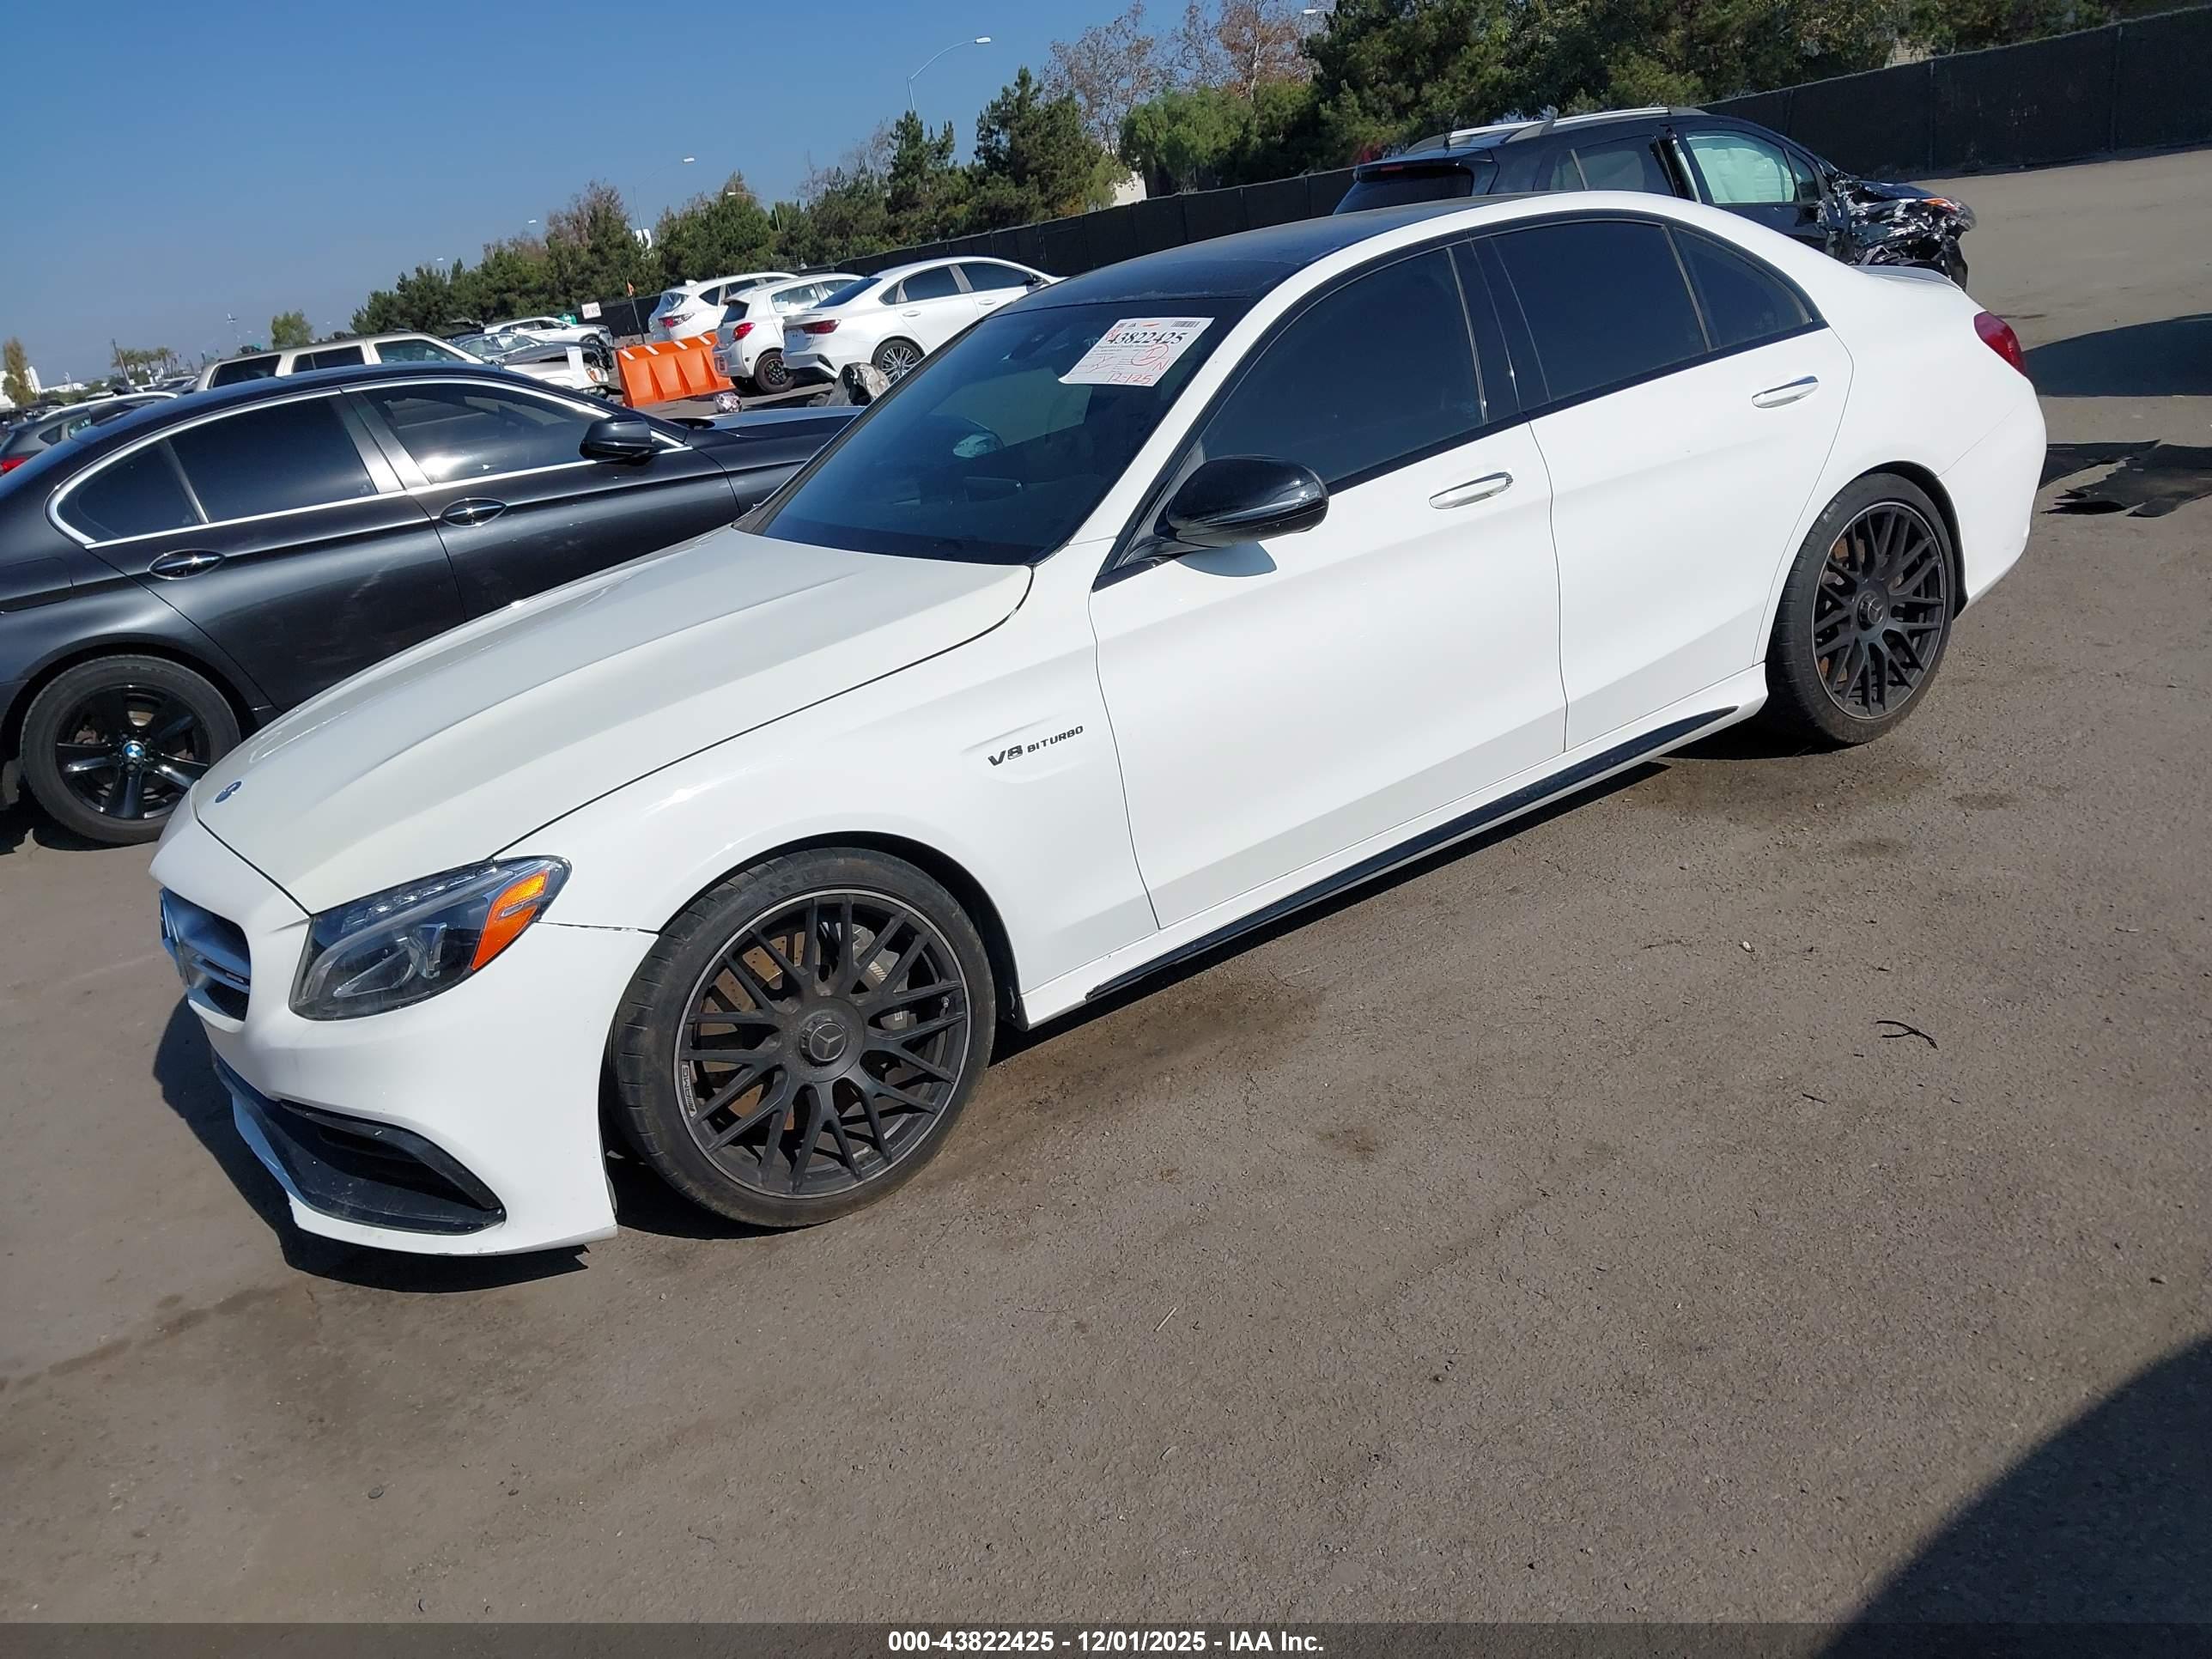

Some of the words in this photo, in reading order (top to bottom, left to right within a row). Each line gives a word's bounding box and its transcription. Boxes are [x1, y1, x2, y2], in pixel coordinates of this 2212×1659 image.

[1107, 331, 1188, 344] 43822425
[988, 745, 1024, 766] V8
[1027, 726, 1084, 753] BITURBO
